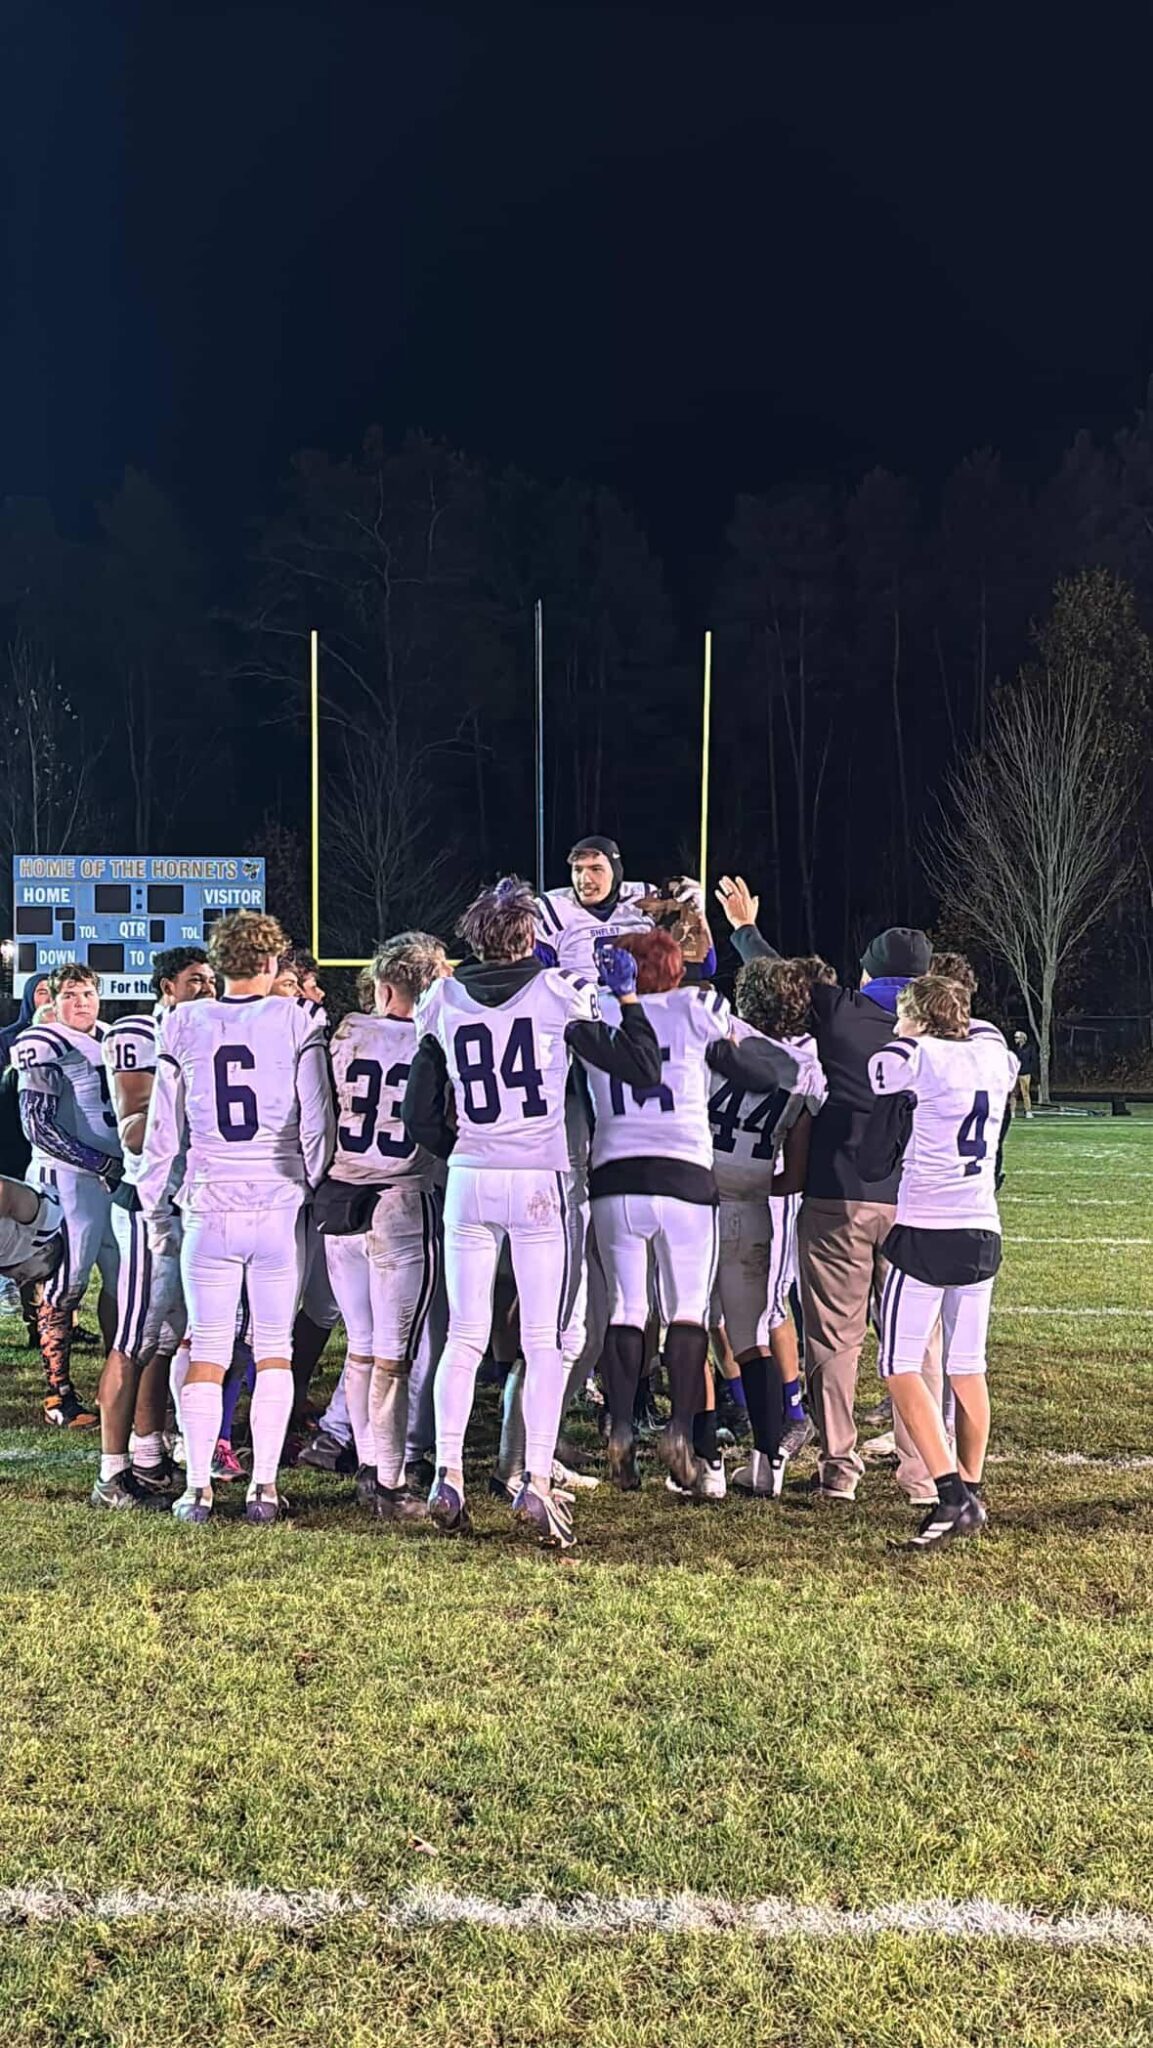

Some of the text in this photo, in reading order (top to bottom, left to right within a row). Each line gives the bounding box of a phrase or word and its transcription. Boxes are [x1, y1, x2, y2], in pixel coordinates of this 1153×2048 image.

[20, 858, 238, 880] HOME OF THE HORNETS
[23, 887, 71, 903] HOME
[204, 888, 262, 905] VISITOR
[79, 925, 99, 939] TOL
[119, 921, 146, 938] QTR
[181, 926, 201, 940] TOL
[39, 949, 76, 965] DOWN
[129, 950, 145, 966] TO
[110, 980, 131, 994] For
[18, 1047, 40, 1071] 52
[115, 1043, 137, 1069] 16
[453, 1017, 548, 1124] 84
[875, 1061, 885, 1089] 4
[213, 1044, 259, 1142] 6
[338, 1058, 417, 1159] 33
[707, 1078, 792, 1160] 44
[956, 1090, 990, 1177] 4
